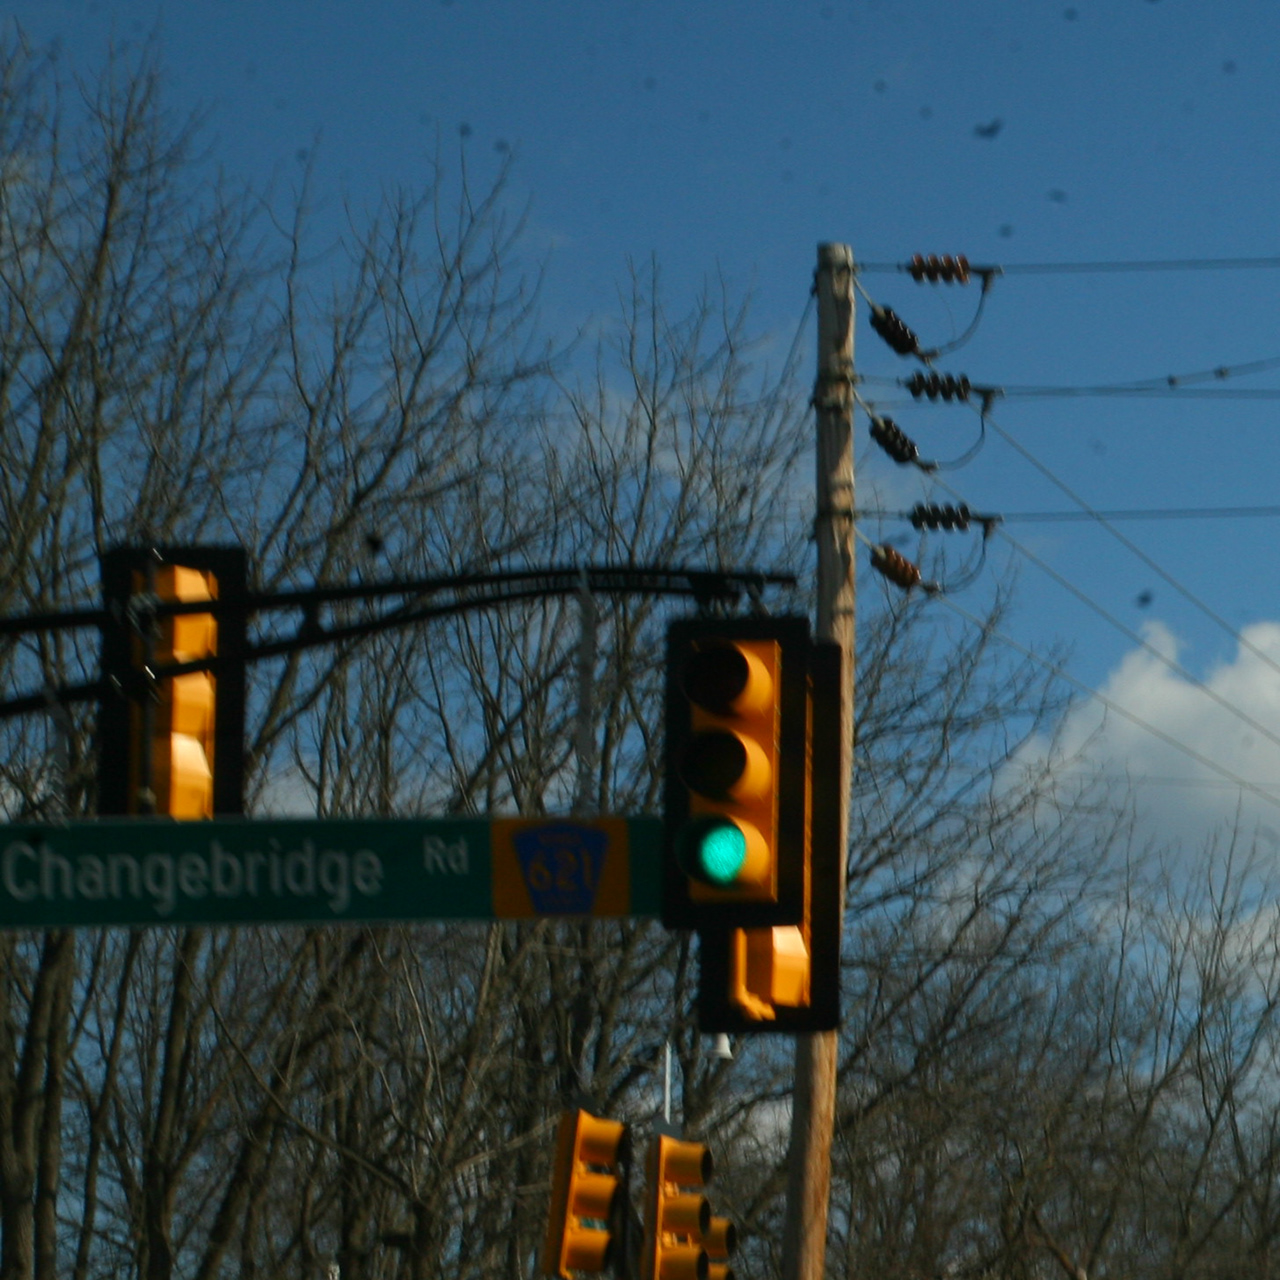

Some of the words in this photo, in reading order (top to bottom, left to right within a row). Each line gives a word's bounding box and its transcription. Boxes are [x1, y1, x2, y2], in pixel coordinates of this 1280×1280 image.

[3, 838, 384, 912] Changebridge
[422, 836, 470, 875] Rd
[529, 846, 595, 893] 621
